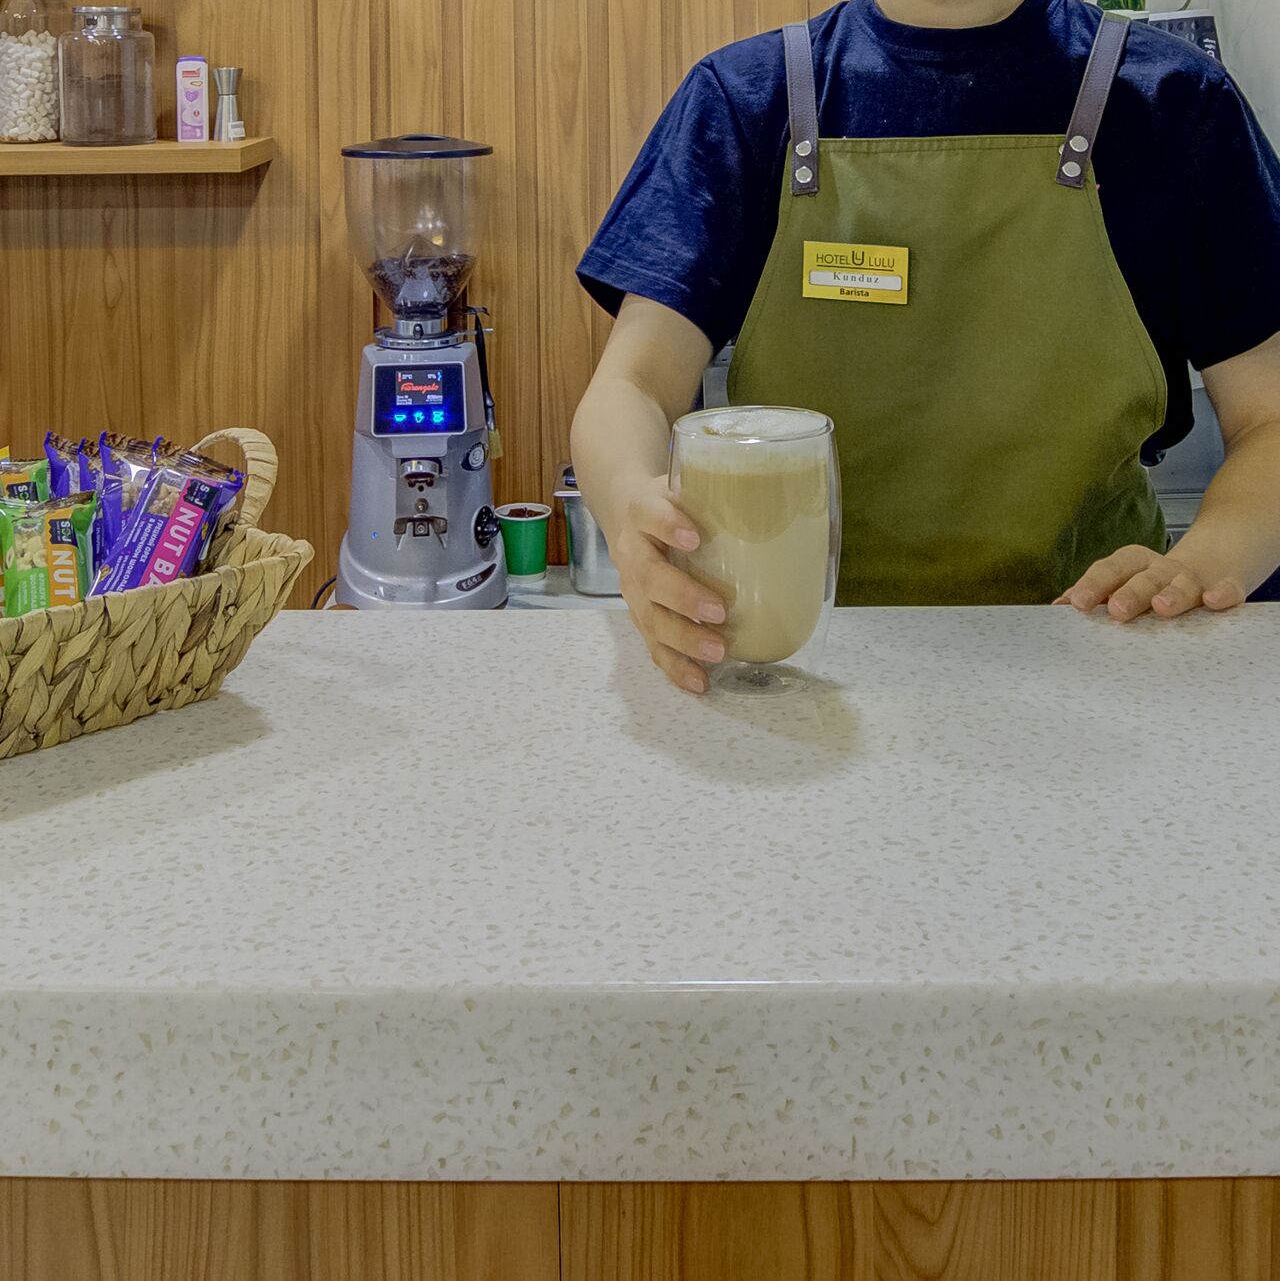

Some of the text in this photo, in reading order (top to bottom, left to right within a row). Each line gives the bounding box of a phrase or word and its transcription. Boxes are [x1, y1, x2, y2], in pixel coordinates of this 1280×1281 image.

[816, 253, 895, 268] HOTEL LULU
[833, 271, 880, 284] Kunduz
[839, 288, 869, 297] Barista
[163, 507, 199, 557] NUT
[51, 550, 76, 599] NUT
[116, 557, 138, 591] ШОКОЛАД
